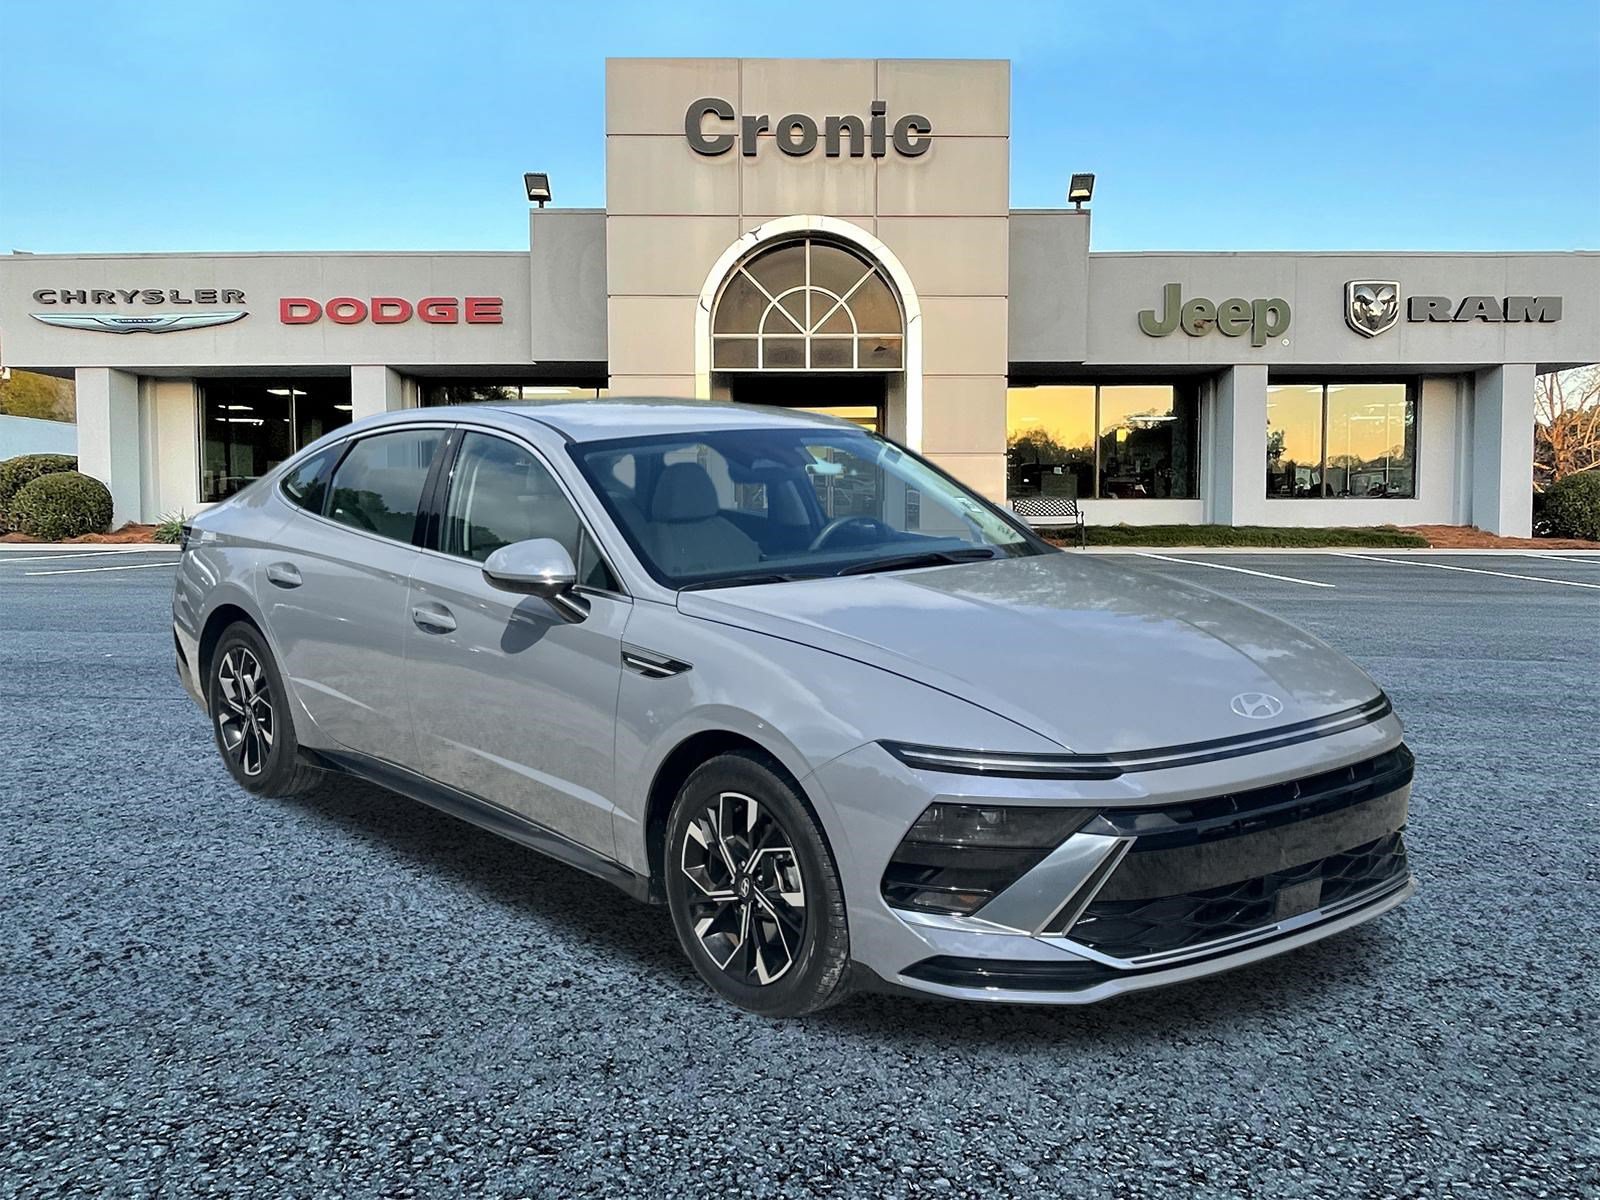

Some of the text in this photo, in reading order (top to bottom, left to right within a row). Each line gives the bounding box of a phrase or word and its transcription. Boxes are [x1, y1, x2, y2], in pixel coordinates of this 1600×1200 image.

[685, 97, 932, 158] Cronic
[32, 289, 246, 304] CHRYSLER
[1407, 296, 1563, 322] RAM
[280, 297, 503, 324] DODGE
[1138, 283, 1291, 347] Jeep
